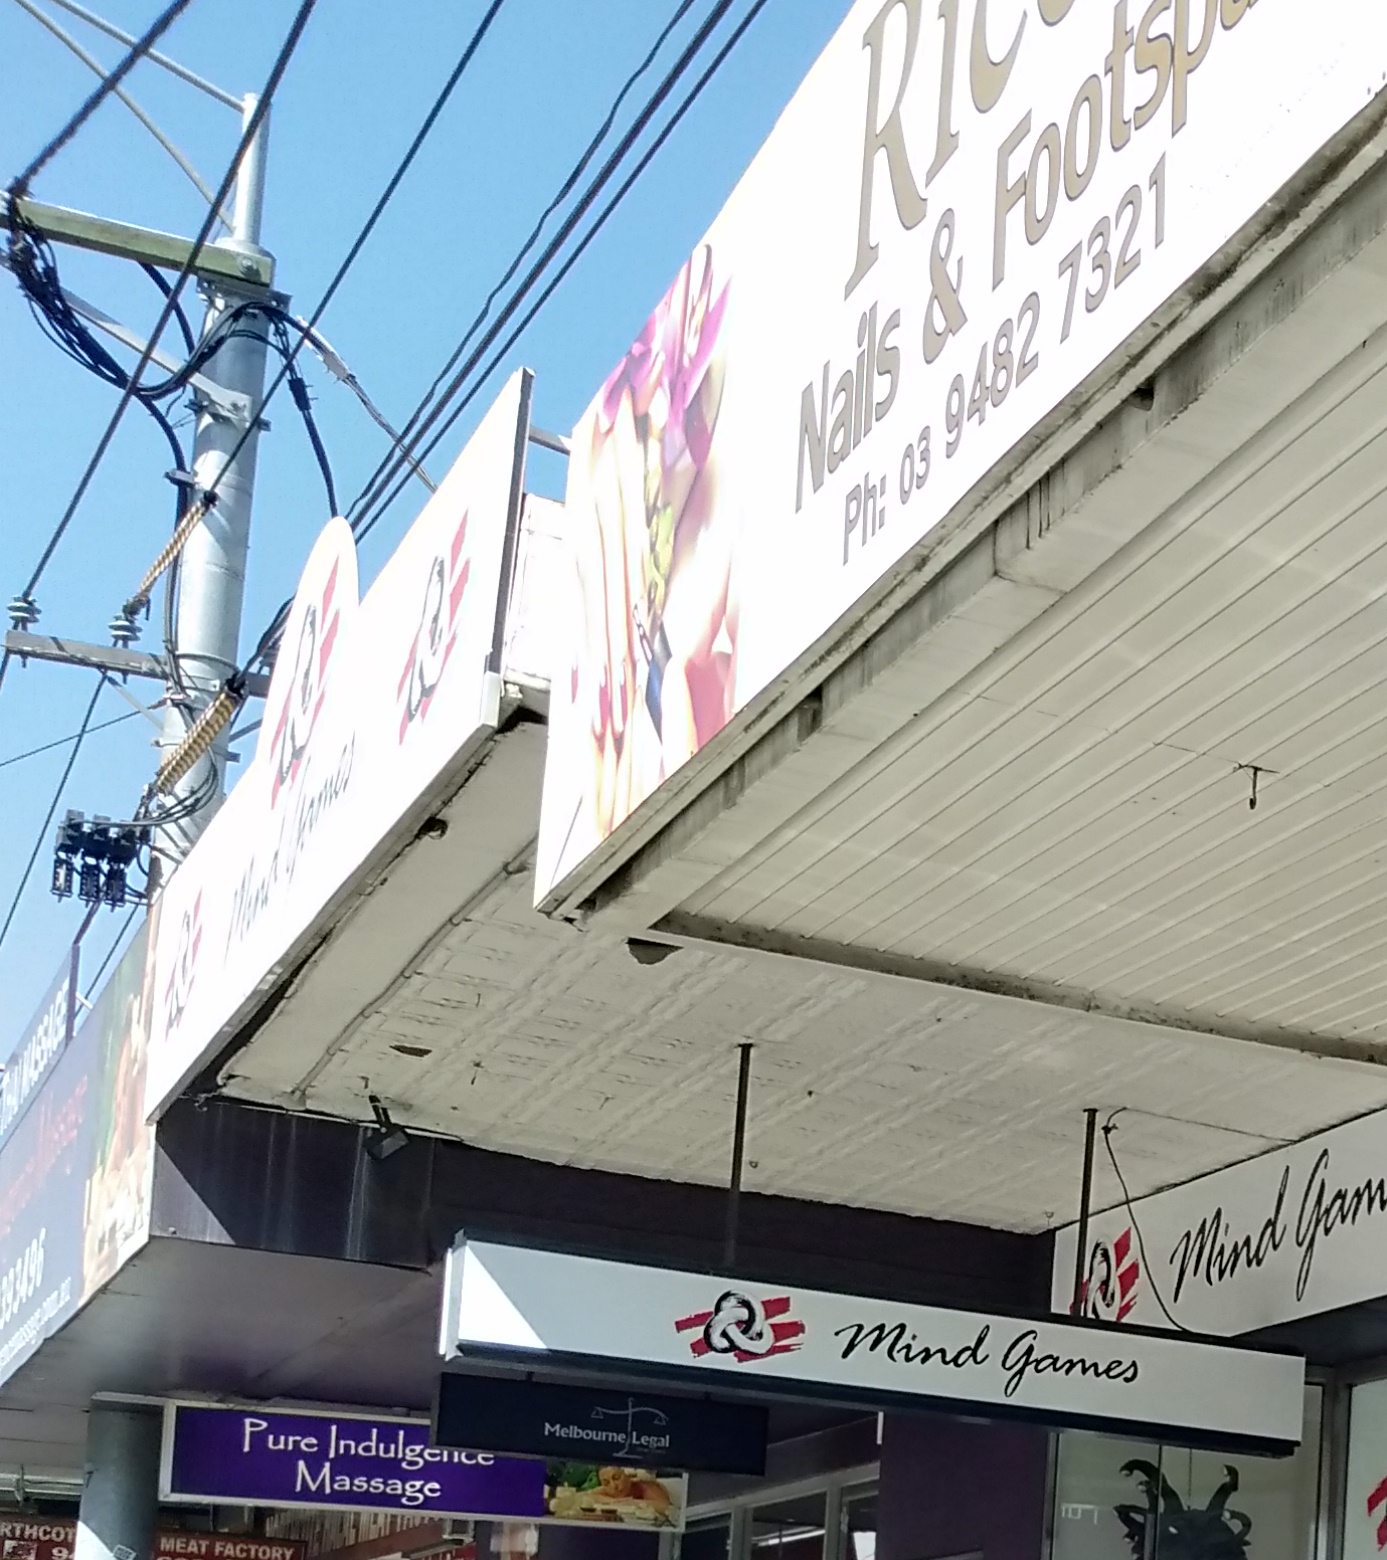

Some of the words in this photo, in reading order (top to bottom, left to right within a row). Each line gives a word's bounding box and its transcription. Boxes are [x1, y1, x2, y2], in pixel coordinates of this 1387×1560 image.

[845, 0, 1078, 300] Ric
[795, 300, 901, 514] Nails
[922, 208, 968, 363] &
[991, 0, 1256, 292] Footsp
[843, 469, 887, 566] Ph:
[900, 426, 932, 505] 03
[945, 291, 1041, 459] 9482
[1058, 151, 1168, 345] 7321
[1169, 1165, 1290, 1303] Mind
[834, 1322, 990, 1368] Mind
[1001, 1329, 1139, 1398] Games
[244, 1419, 318, 1453] Pure
[545, 1422, 626, 1444] Melbourne
[632, 1430, 670, 1449] Legal
[295, 1460, 442, 1504] Massage
[160, 1536, 208, 1553] MEAT
[215, 1542, 295, 1560] FACTORY
